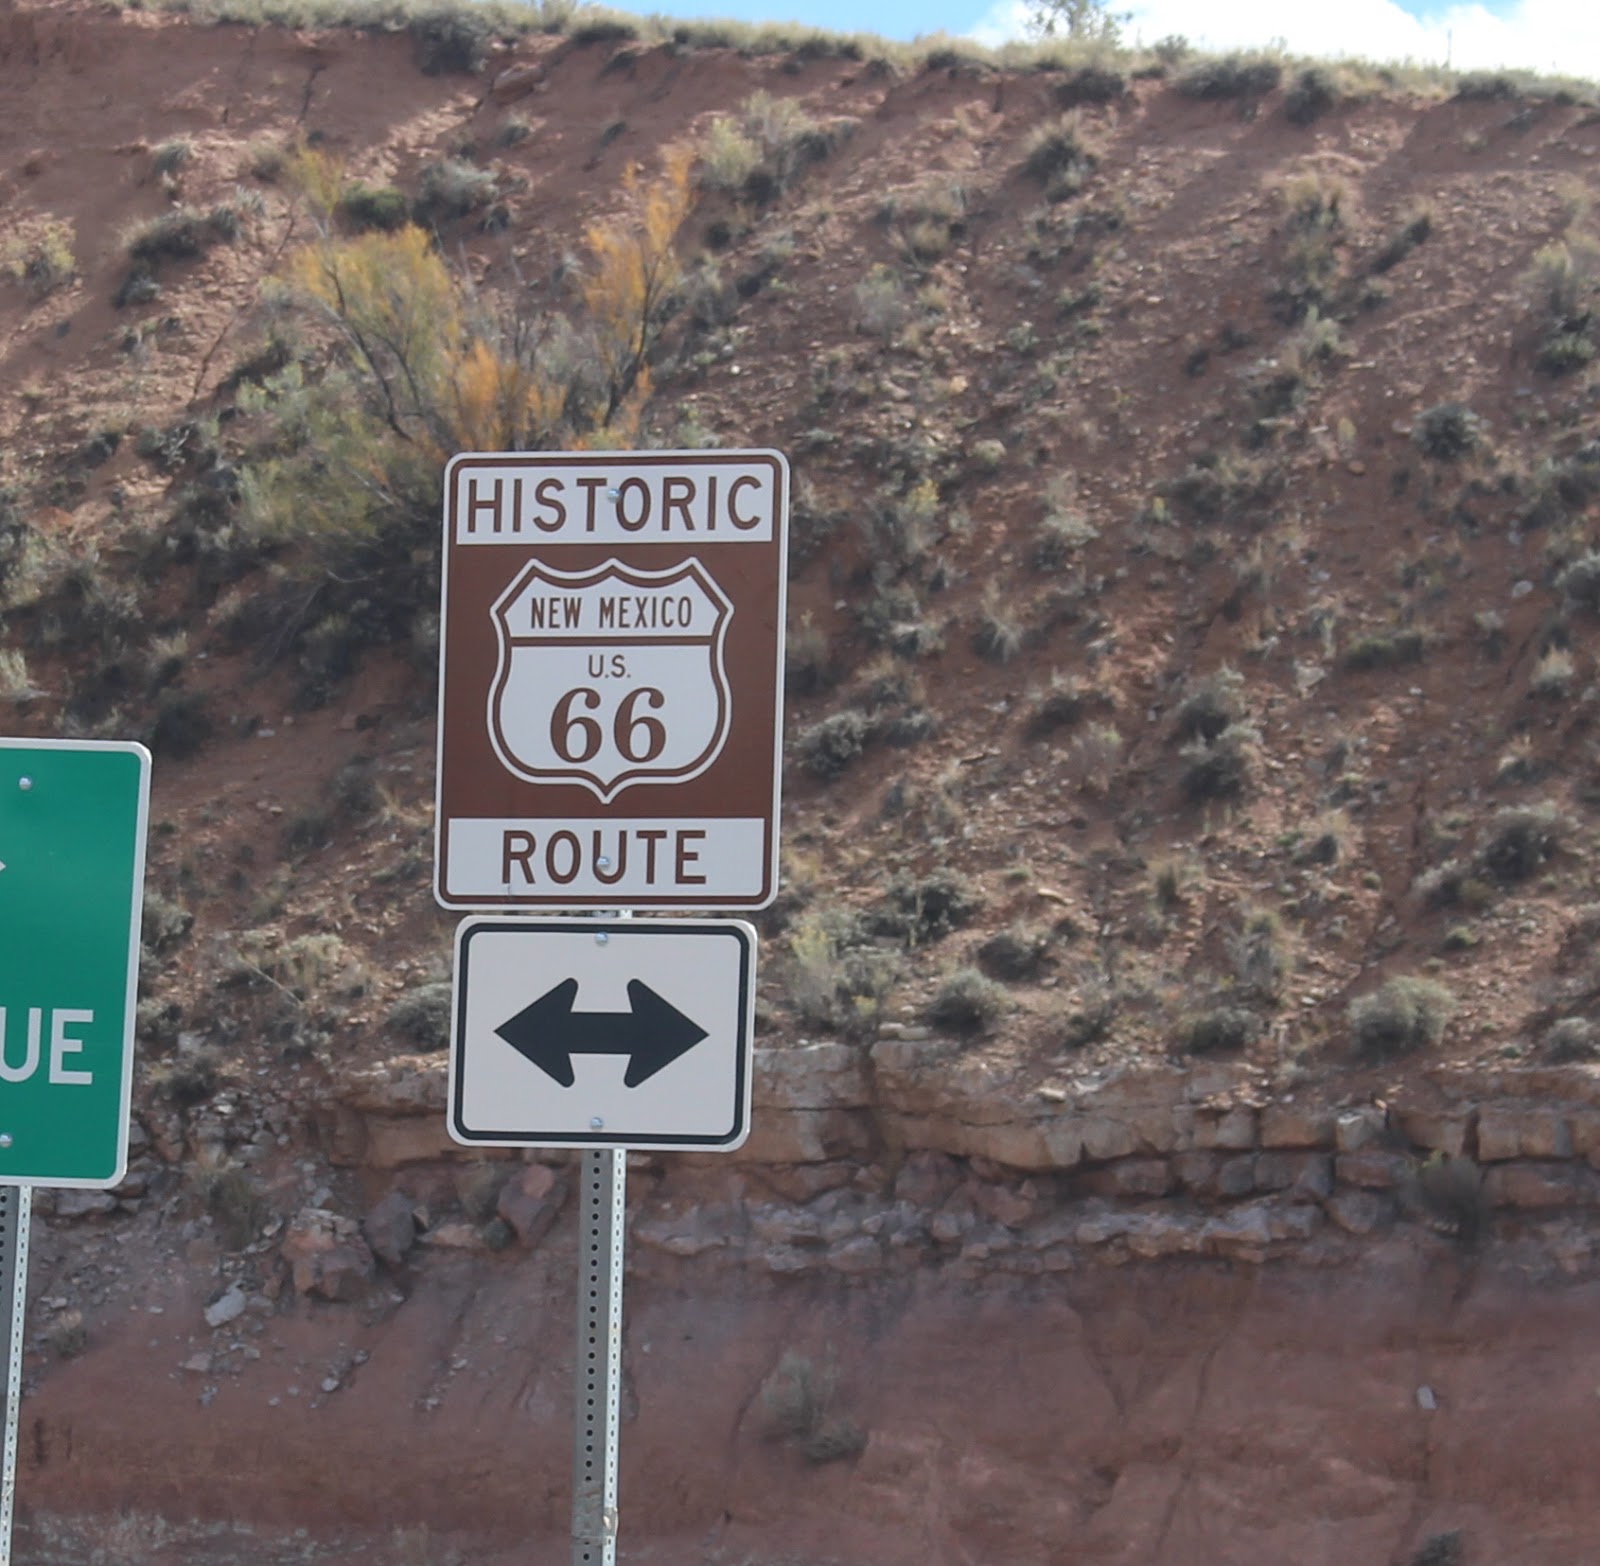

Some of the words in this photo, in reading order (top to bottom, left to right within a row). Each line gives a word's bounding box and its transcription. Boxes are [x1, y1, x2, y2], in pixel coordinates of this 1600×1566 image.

[467, 475, 763, 533] HISTORIC
[531, 597, 582, 629] NEW
[599, 596, 692, 628] MEXICO
[587, 654, 632, 679] U.S.
[550, 687, 667, 764] 66
[502, 830, 707, 885] ROUTE
